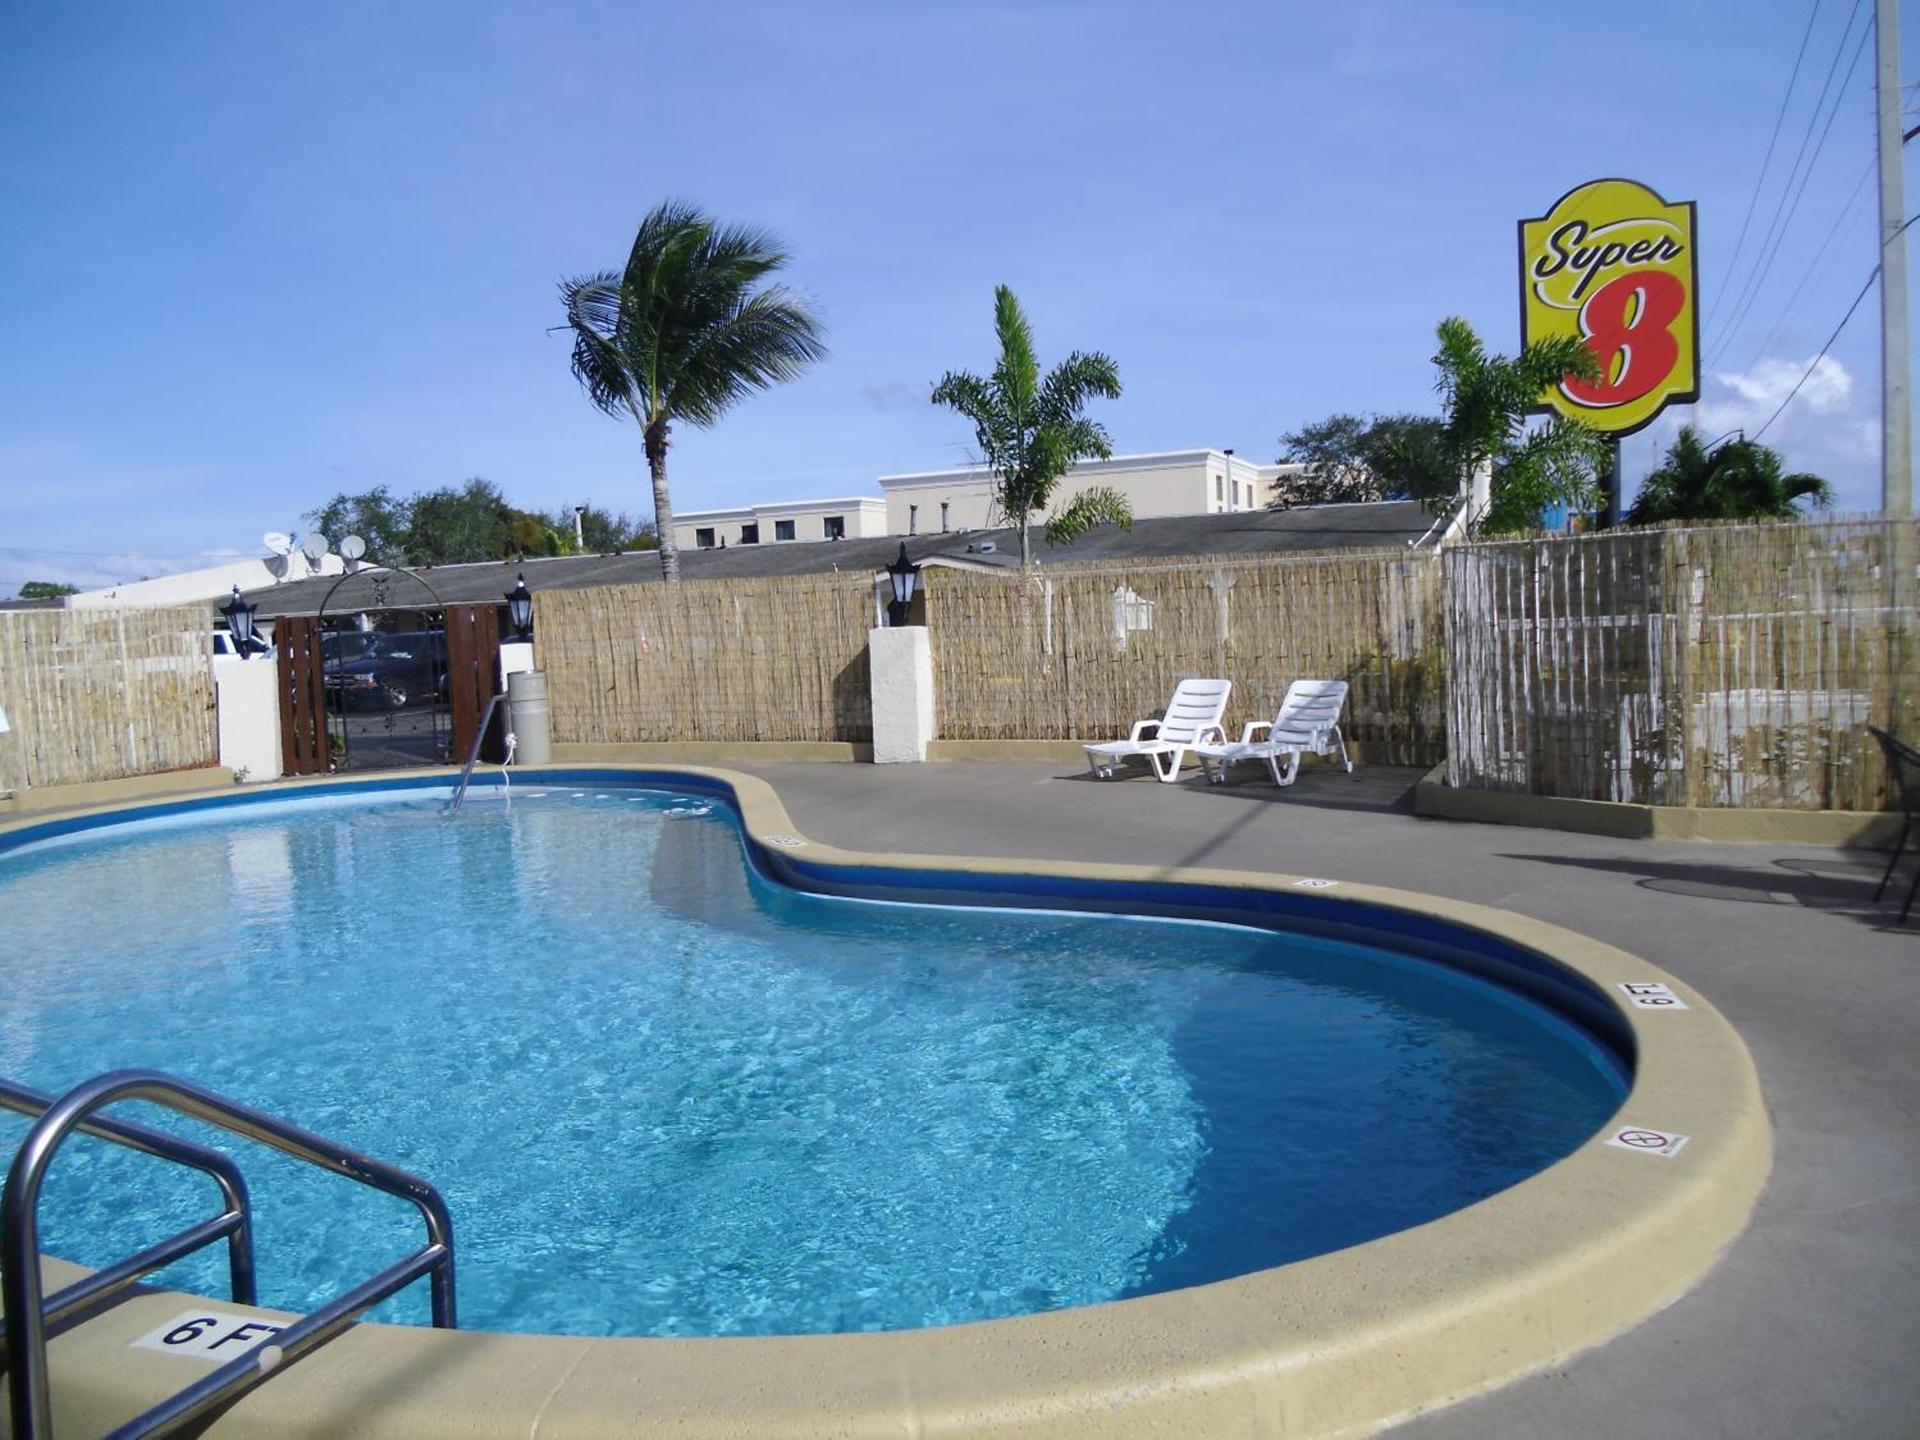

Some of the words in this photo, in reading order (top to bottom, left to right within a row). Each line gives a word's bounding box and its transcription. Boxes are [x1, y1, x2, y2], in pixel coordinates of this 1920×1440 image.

[1533, 220, 1685, 301] Super
[1557, 269, 1686, 409] 8
[1639, 998, 1675, 1006] 6
[163, 1317, 218, 1345] 6
